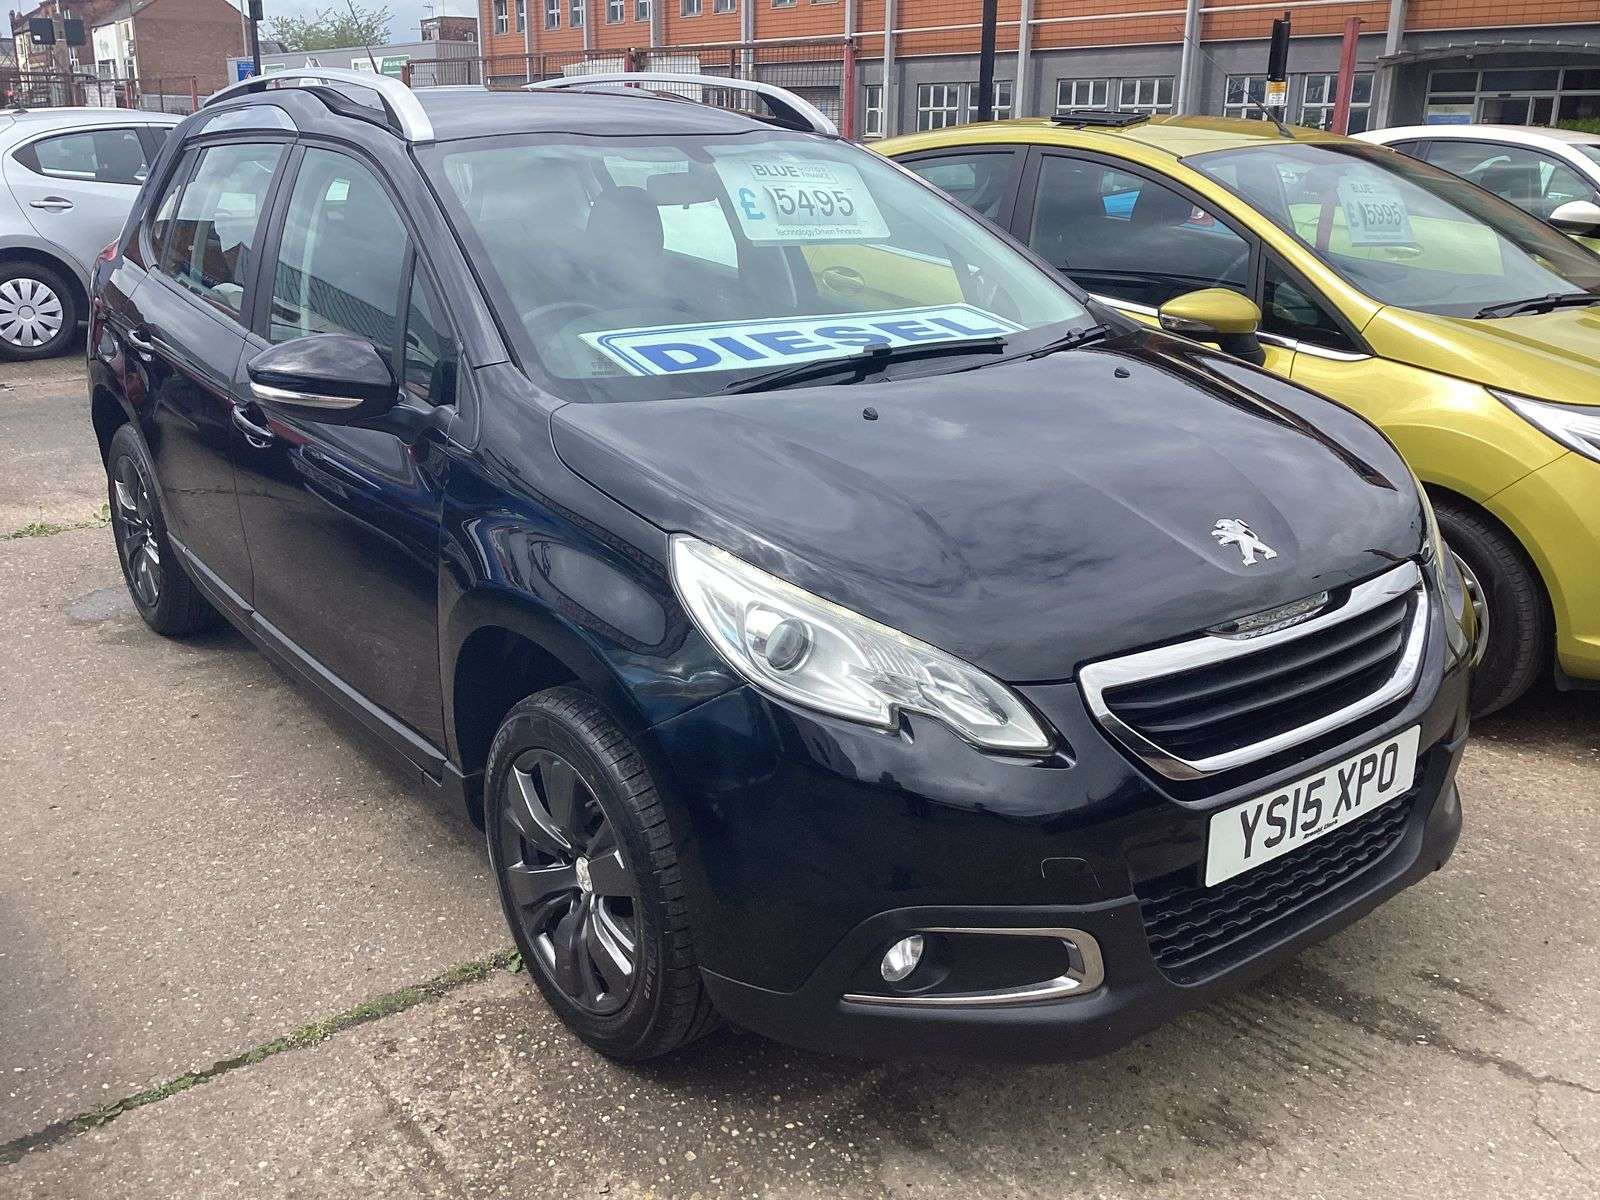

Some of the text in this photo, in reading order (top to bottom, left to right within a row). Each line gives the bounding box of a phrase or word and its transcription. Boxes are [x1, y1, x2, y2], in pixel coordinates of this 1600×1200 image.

[752, 164, 800, 177] BLUE
[738, 187, 855, 220] £ 5495
[1364, 203, 1401, 226] 5995
[633, 317, 1007, 372] DIESEL
[1240, 742, 1399, 860] YS15 XPO
